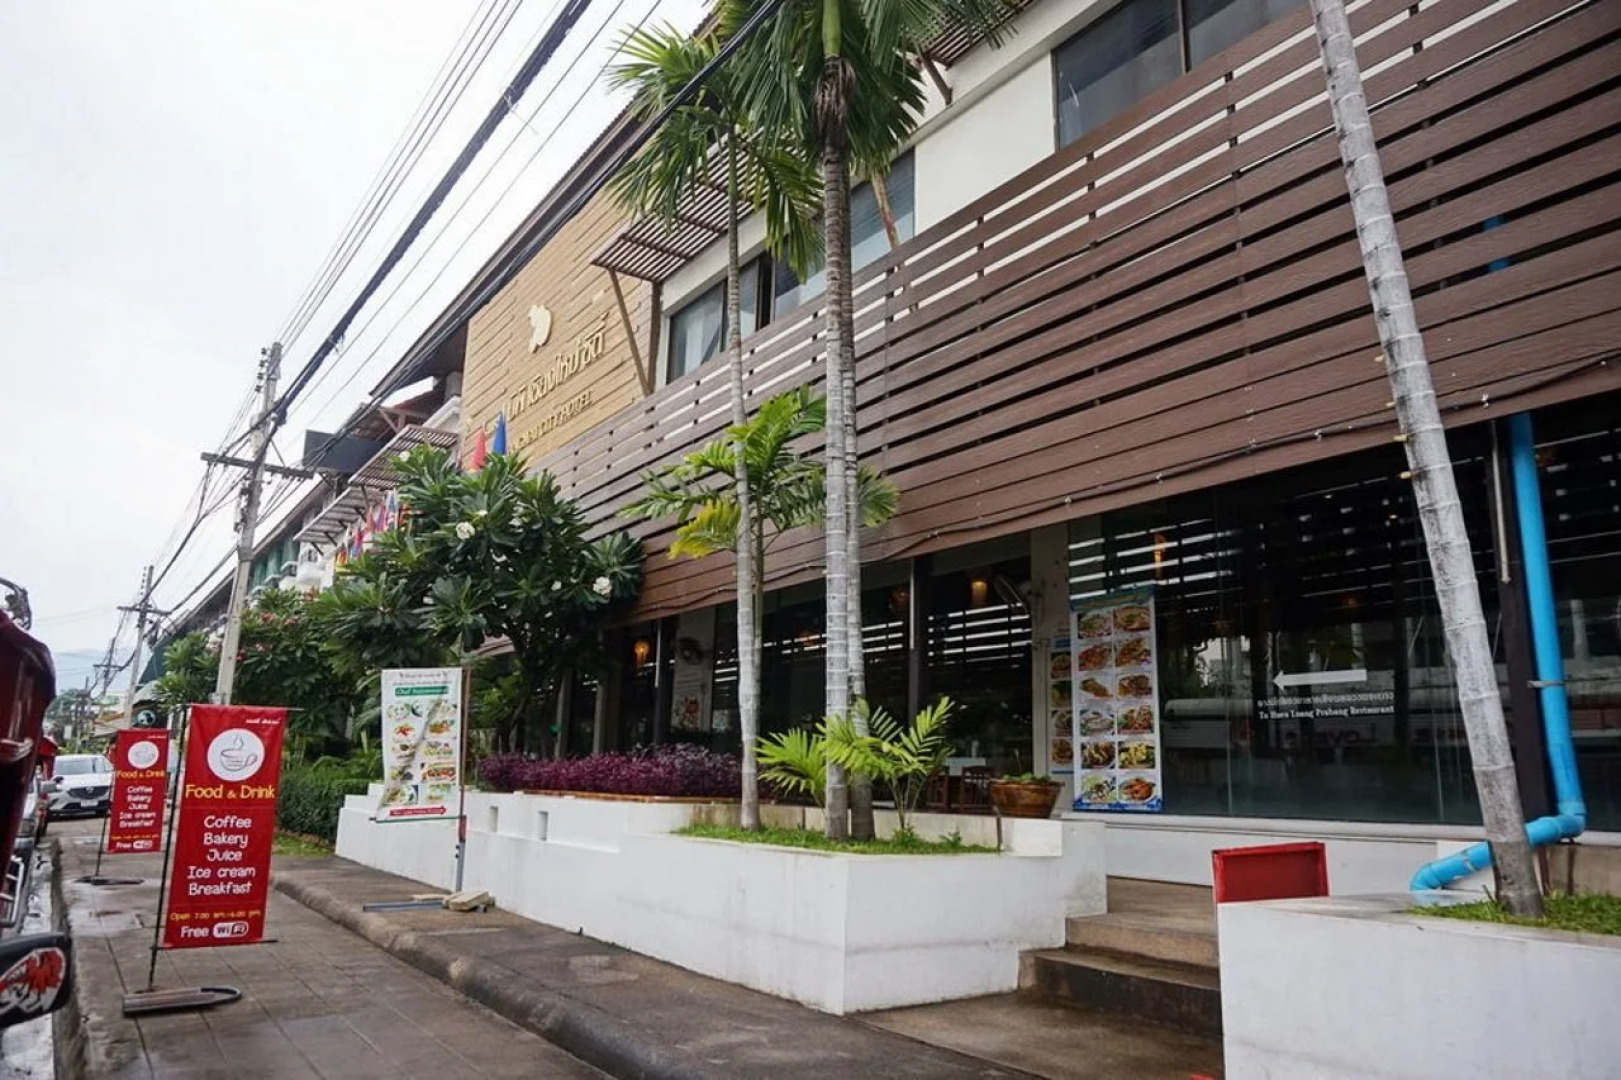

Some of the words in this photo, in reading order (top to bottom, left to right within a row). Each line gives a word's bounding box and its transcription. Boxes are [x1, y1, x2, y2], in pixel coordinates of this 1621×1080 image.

[1349, 705, 1395, 715] Restaurant
[117, 770, 138, 779] Food
[127, 786, 153, 794] Coffee
[185, 785, 224, 799] Food
[227, 789, 237, 799] &
[240, 785, 276, 799] Drink
[127, 795, 152, 804] Bakery
[119, 819, 154, 828] Breakfast
[203, 815, 252, 829] Coffee
[203, 831, 249, 849] Bakery
[206, 848, 243, 862] Juice
[186, 866, 212, 879] Ice
[217, 866, 256, 878] cream
[188, 881, 253, 895] Breakfast
[170, 912, 191, 921] Open
[180, 926, 210, 938] Free
